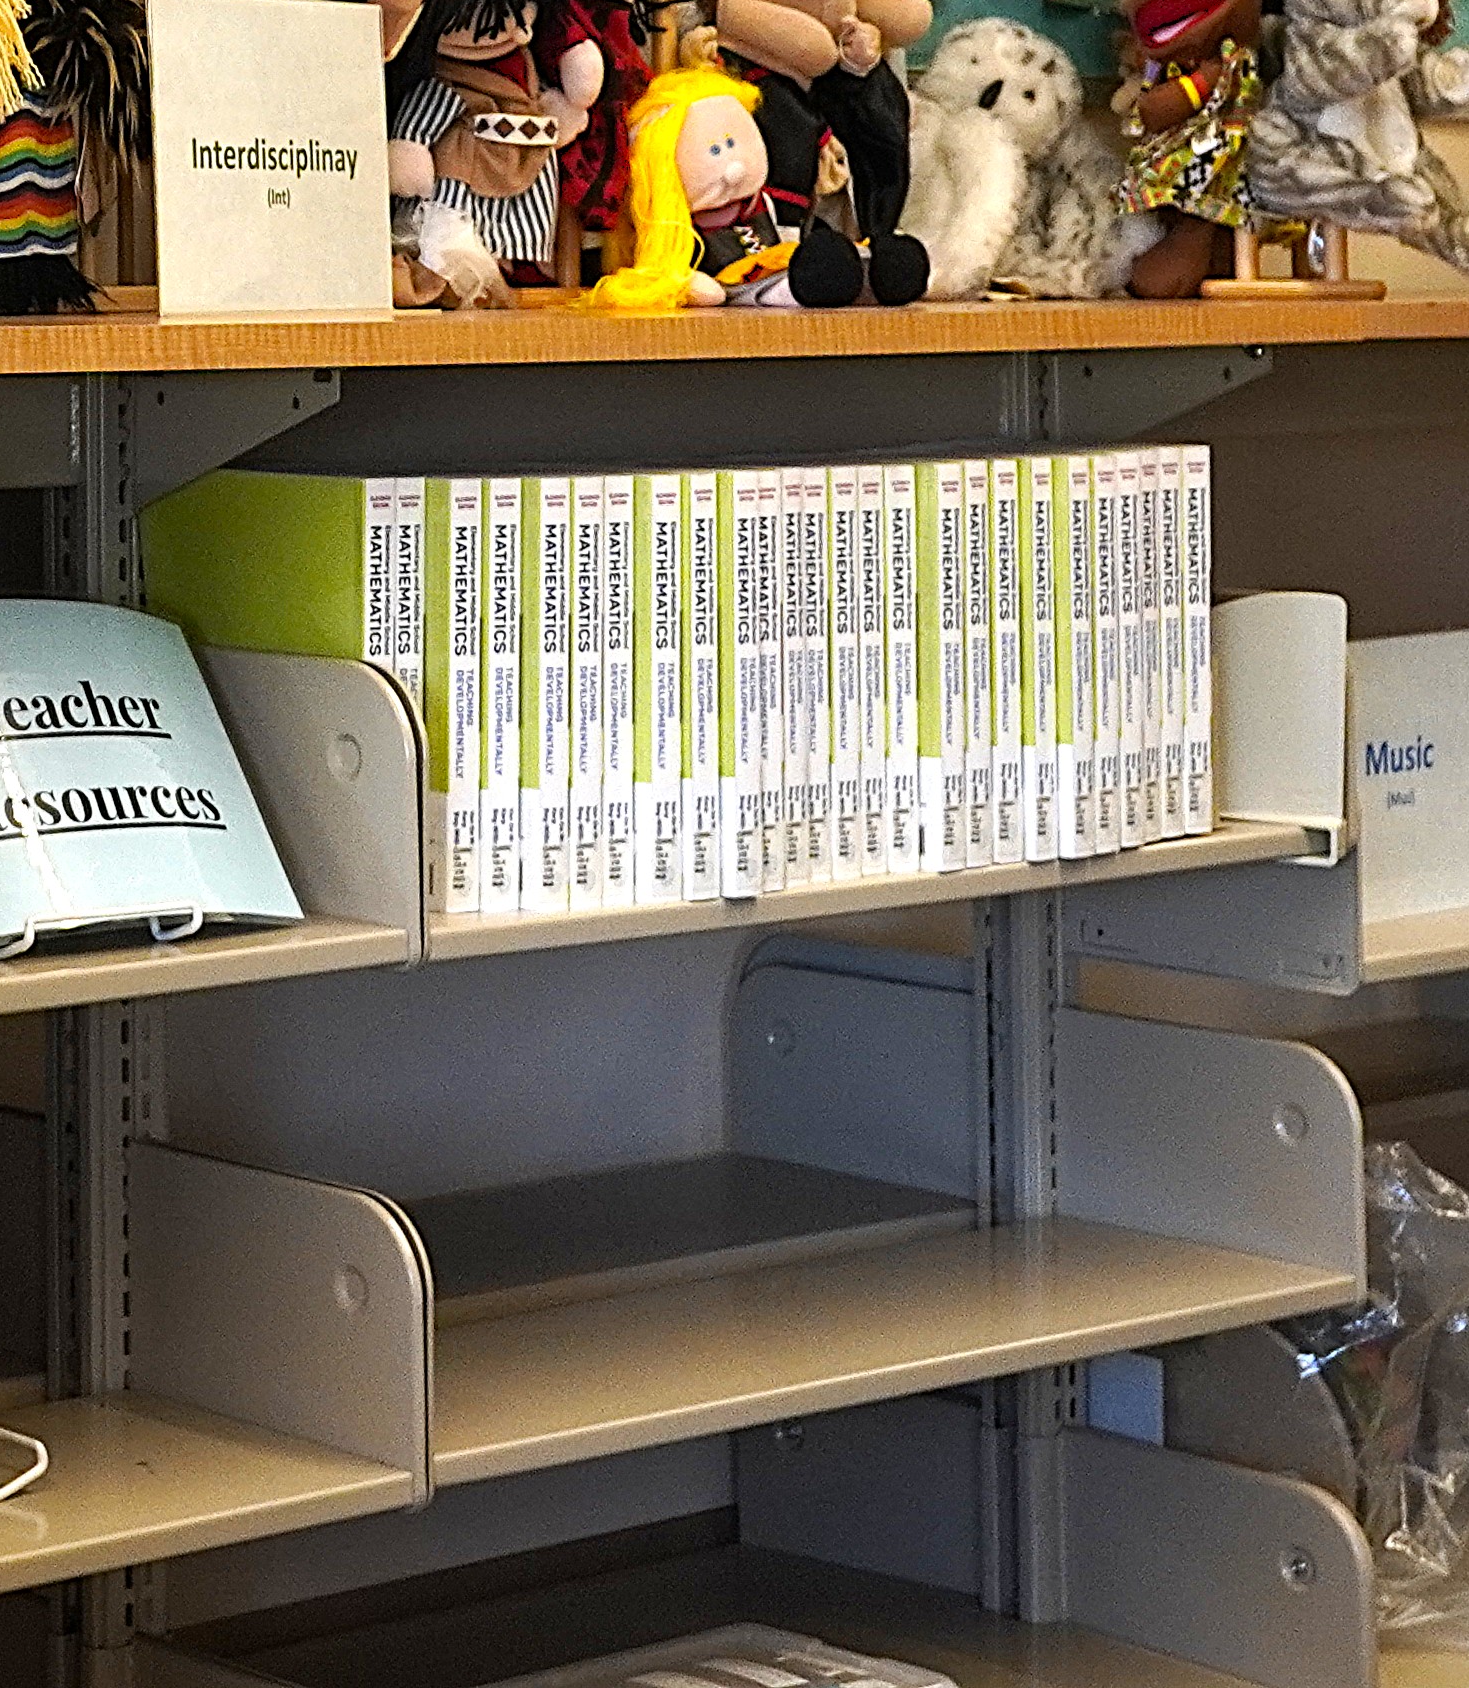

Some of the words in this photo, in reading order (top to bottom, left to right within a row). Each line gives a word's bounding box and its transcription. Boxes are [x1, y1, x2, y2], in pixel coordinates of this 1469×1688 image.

[192, 138, 358, 181] Interdisciplinay
[267, 187, 291, 209] (Int)
[368, 525, 382, 657] MATHEMATICS
[454, 525, 468, 657] MATHEMATICS
[544, 524, 558, 656] MATHEMATICS
[655, 521, 669, 650] MATHEMATICS
[1188, 487, 1200, 605] MATHEMATICS
[1364, 734, 1435, 777] Music
